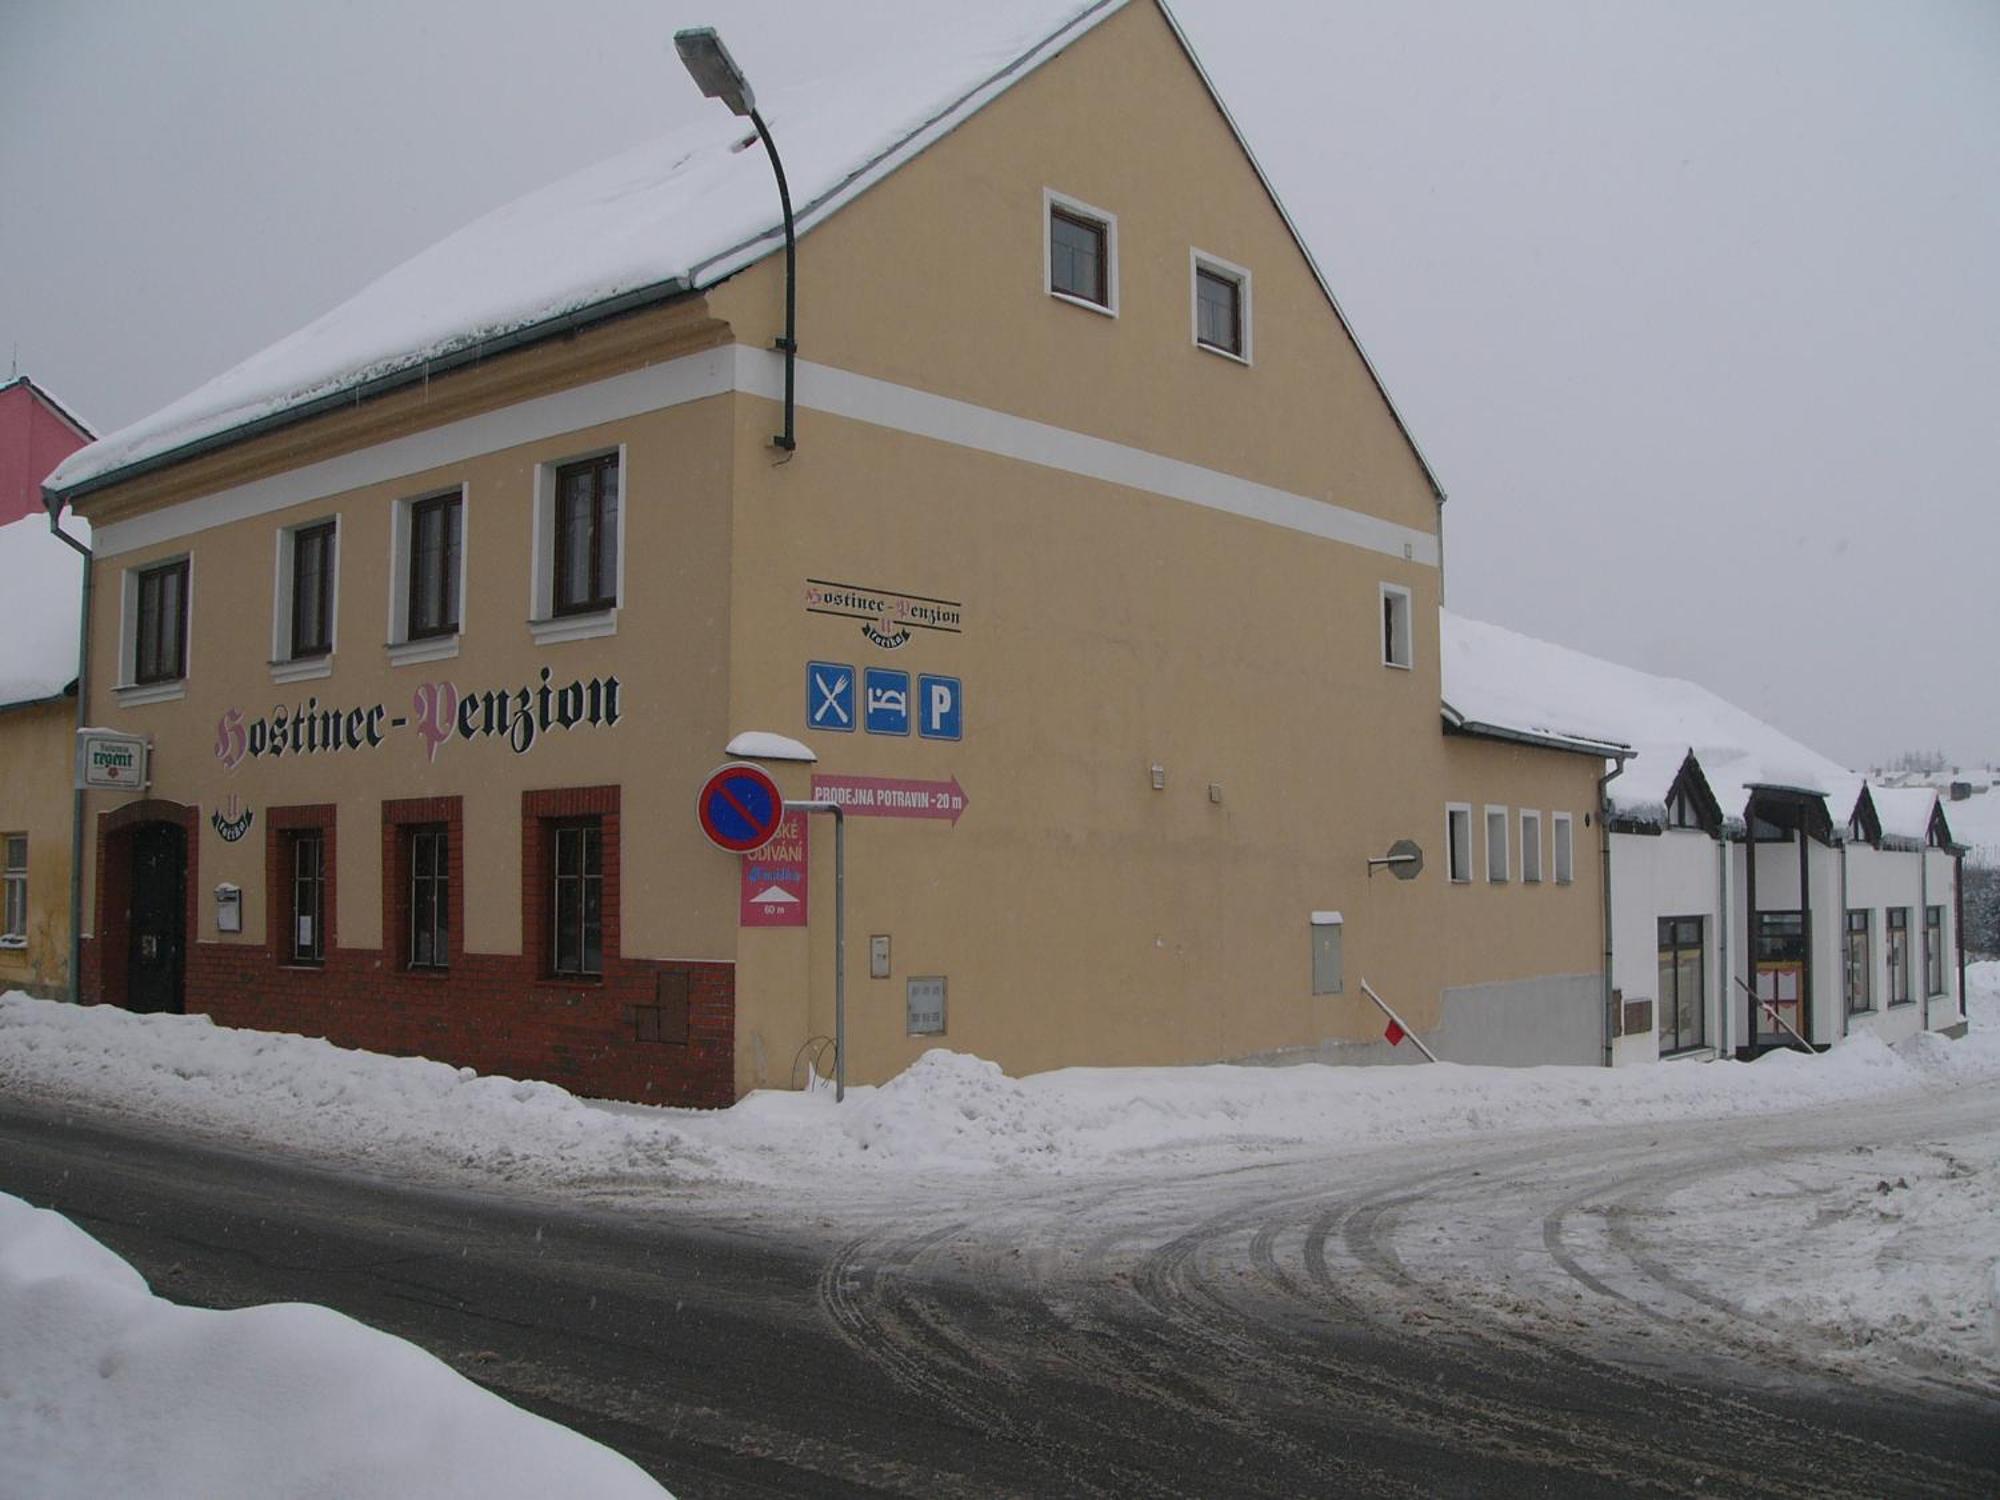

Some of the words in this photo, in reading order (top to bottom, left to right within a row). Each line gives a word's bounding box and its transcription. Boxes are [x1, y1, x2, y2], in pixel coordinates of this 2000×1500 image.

[931, 685, 951, 729] P
[815, 787, 875, 805] PRODEJNA
[876, 790, 929, 808] POTRAVIN
[936, 793, 949, 809] 20
[951, 796, 963, 809] m
